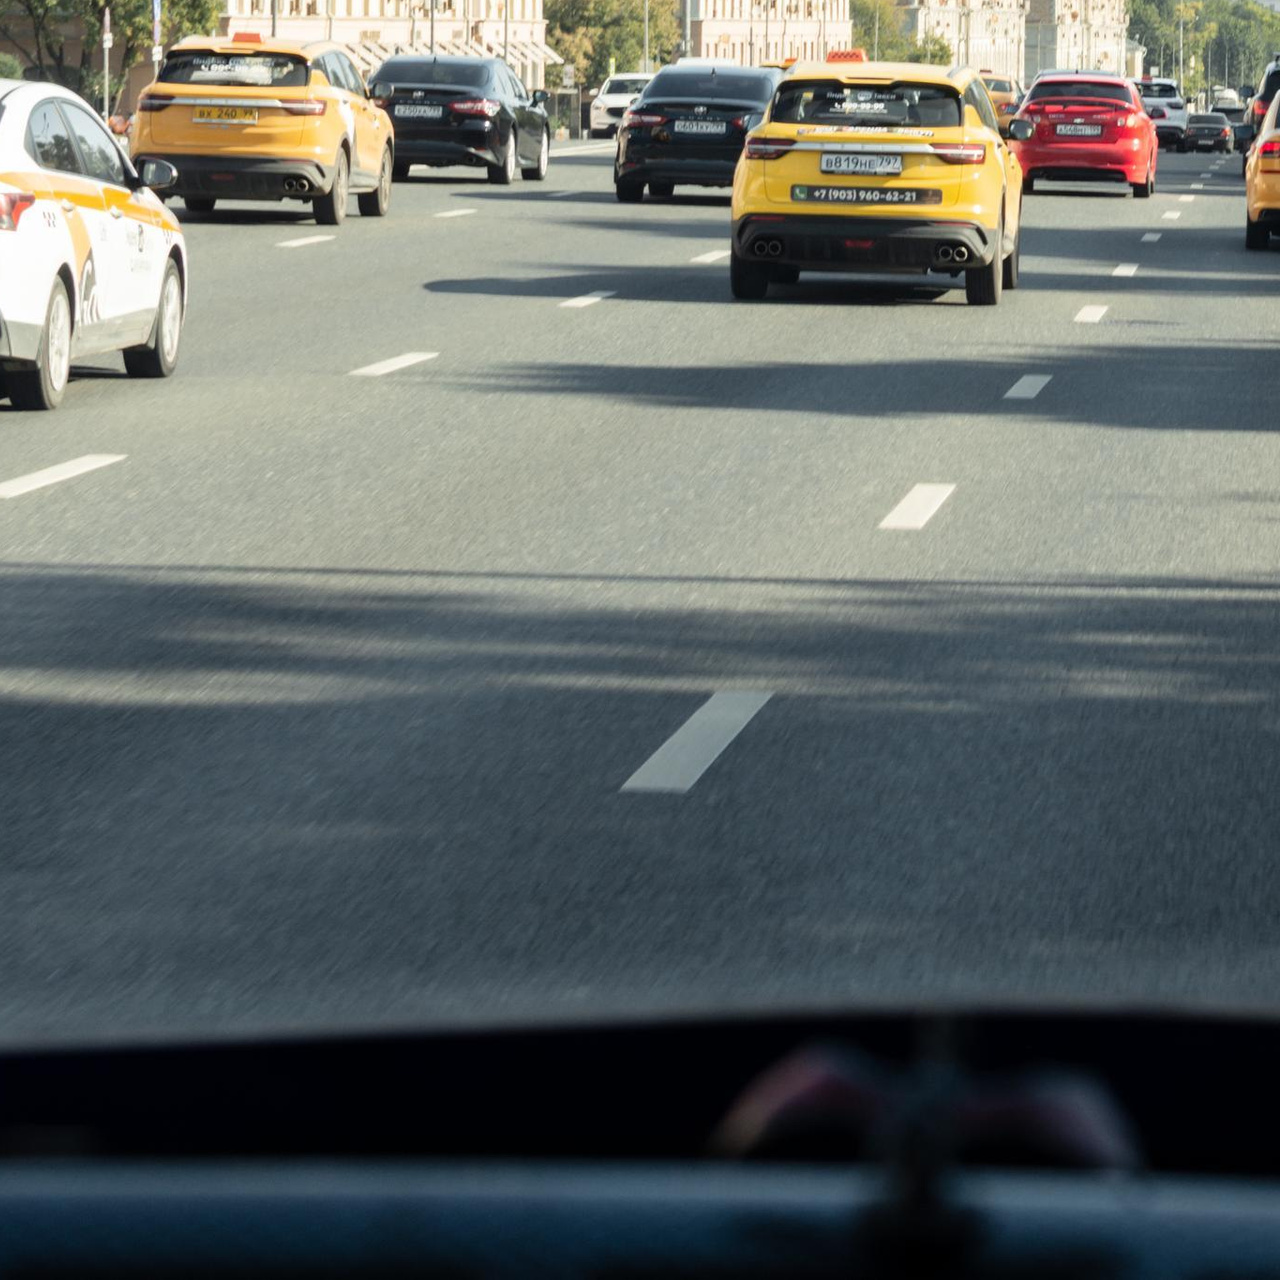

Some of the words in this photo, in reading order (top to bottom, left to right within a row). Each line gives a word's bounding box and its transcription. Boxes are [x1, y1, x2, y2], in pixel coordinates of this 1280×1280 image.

[813, 189, 826, 200] +7
[828, 188, 857, 201] (903)
[859, 190, 917, 202] 960-62-21
